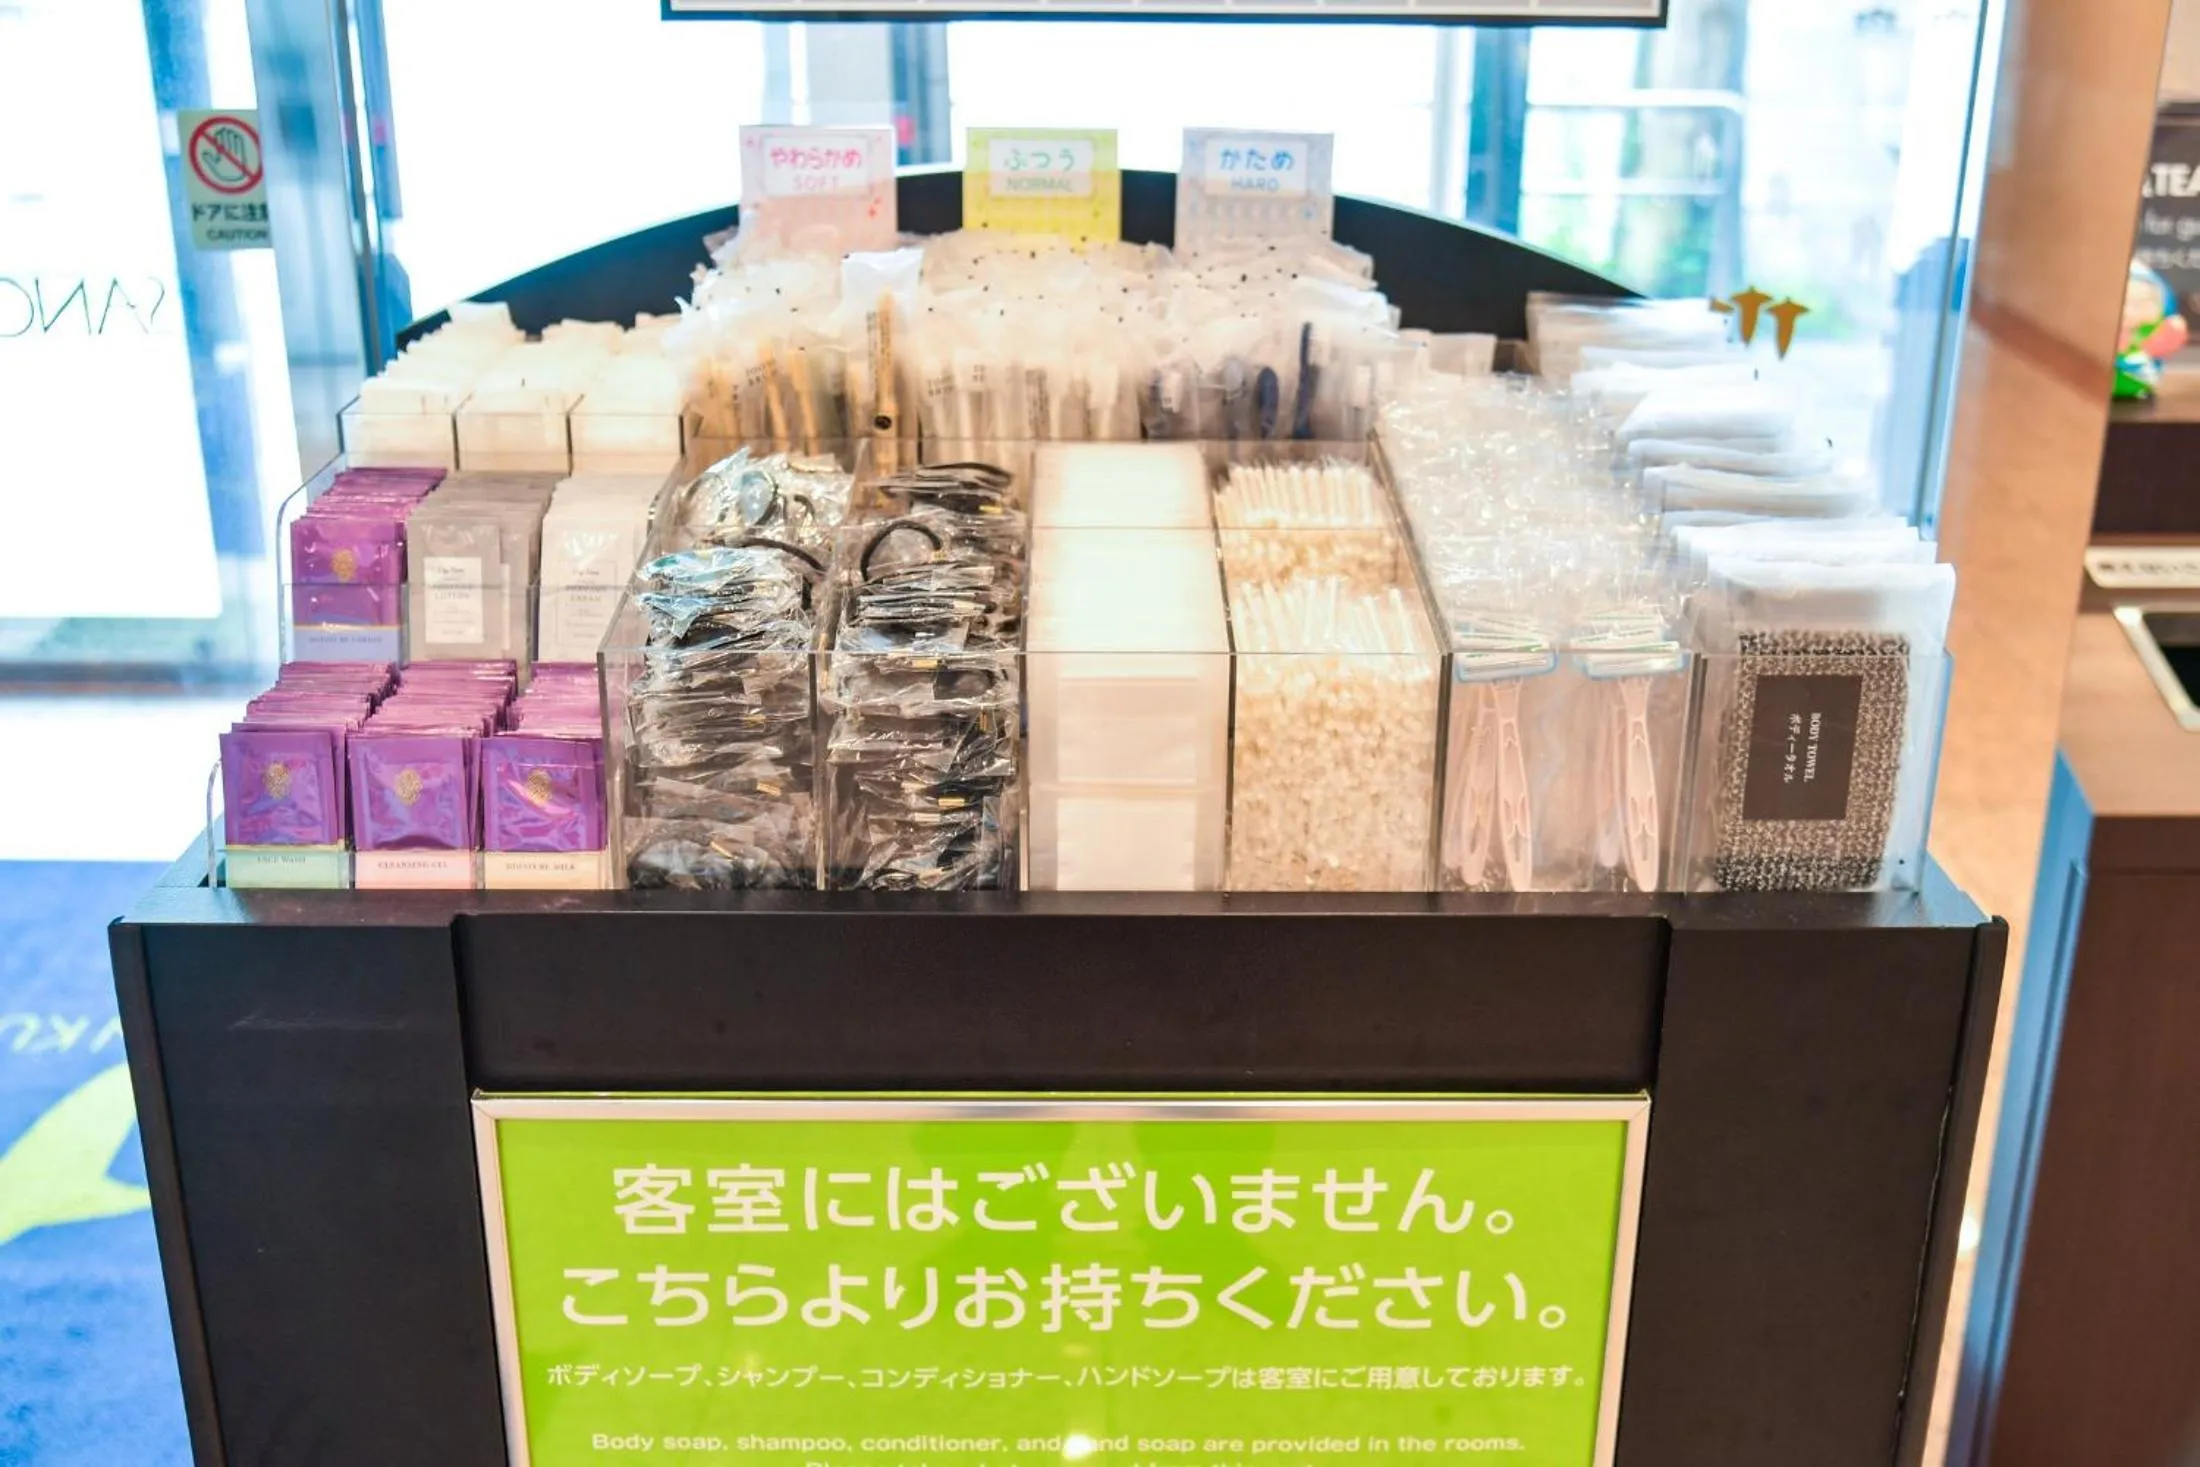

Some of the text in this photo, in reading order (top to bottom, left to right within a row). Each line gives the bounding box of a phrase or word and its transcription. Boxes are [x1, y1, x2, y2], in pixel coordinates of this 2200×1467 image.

[770, 147, 862, 171] やわらかめ
[1003, 147, 1075, 171] ふつう
[1219, 148, 1295, 171] かため
[791, 175, 841, 191] SOFT
[1006, 177, 1073, 192] NORMAL
[1231, 176, 1280, 192] HARD
[1783, 713, 1802, 784] ボディータオル
[1803, 712, 1821, 783] BODY TOWEL
[612, 1162, 1515, 1234] 客室にはございません。
[562, 1263, 1567, 1332] こちらよりお持ちください。
[547, 1363, 1586, 1389] ボディソープ、シャンプー、コンディショナー、ハンドソープは客室にご用意しております。
[591, 1433, 654, 1452] Body
[662, 1435, 728, 1452] soap,
[736, 1434, 853, 1452] shampoo,
[860, 1435, 1009, 1452] conditioner,
[1016, 1435, 1064, 1451] and
[1137, 1437, 1196, 1454] soap
[1203, 1438, 1244, 1451] are
[1251, 1436, 1360, 1454] provided
[1368, 1436, 1390, 1452] in
[1397, 1436, 1437, 1452] the
[1444, 1437, 1526, 1452] rooms.
